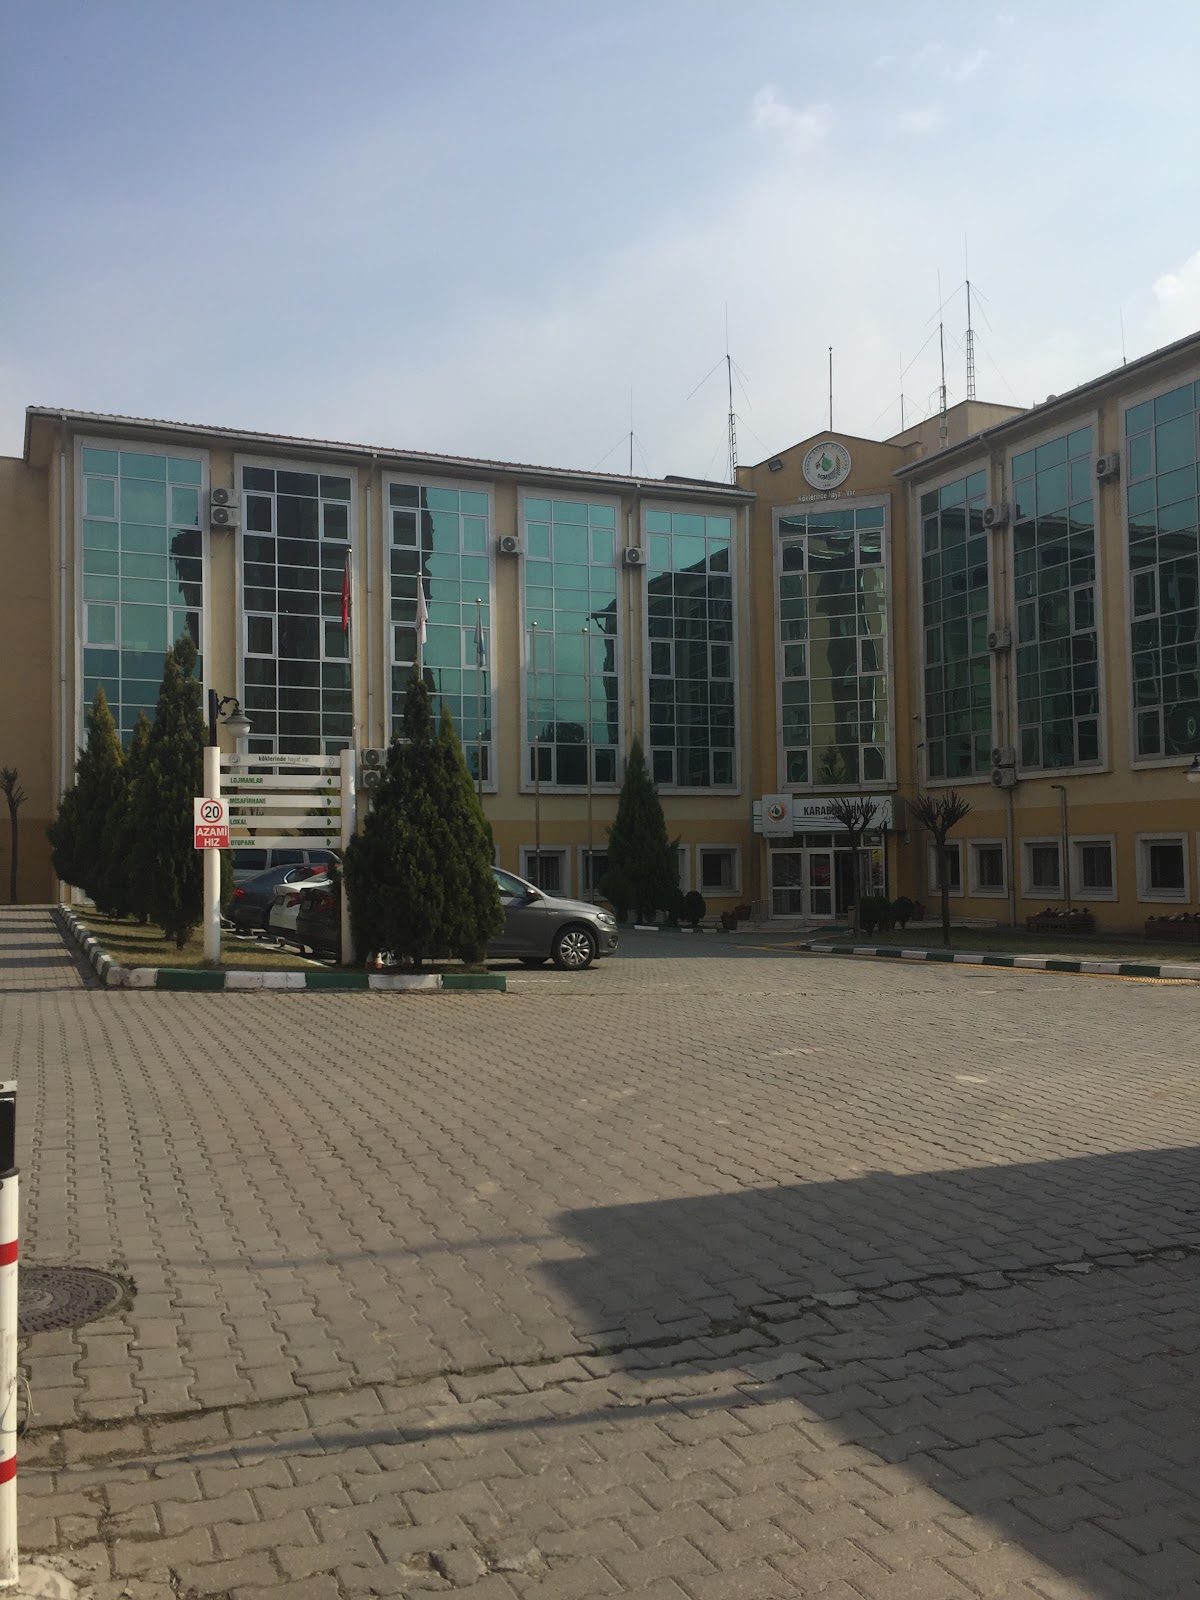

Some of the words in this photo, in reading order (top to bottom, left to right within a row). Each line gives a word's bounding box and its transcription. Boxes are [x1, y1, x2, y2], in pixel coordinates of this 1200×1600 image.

[204, 805, 220, 819] 20
[196, 826, 227, 836] AZAMİ
[203, 838, 220, 847] HIZ
